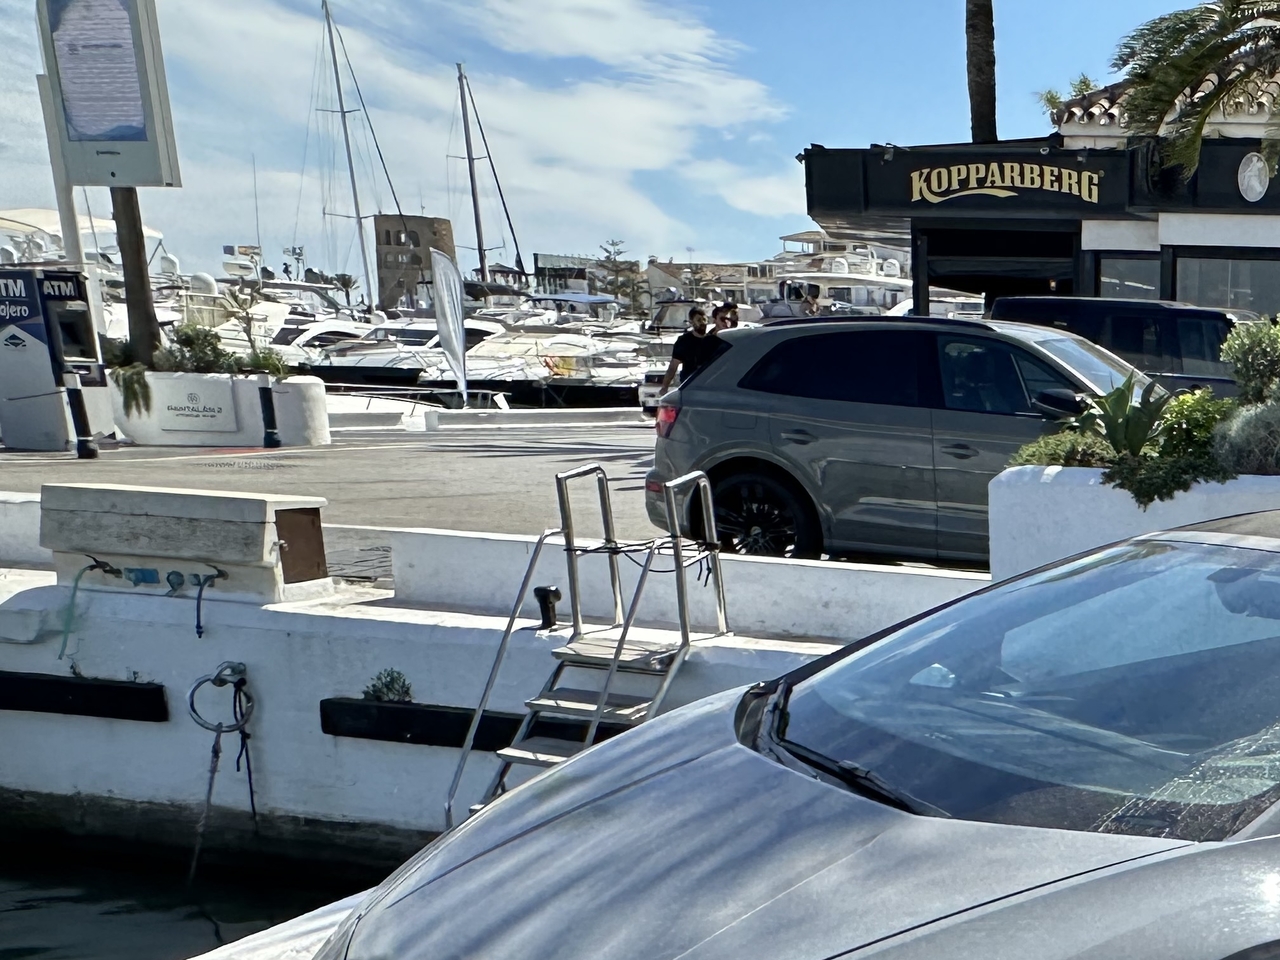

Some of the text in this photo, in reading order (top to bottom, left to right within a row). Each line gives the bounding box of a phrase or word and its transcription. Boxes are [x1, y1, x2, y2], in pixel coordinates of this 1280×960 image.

[910, 162, 1099, 204] KOPPARBERG
[0, 278, 26, 297] TM
[43, 280, 76, 297] ATM
[0, 301, 29, 320] ajero
